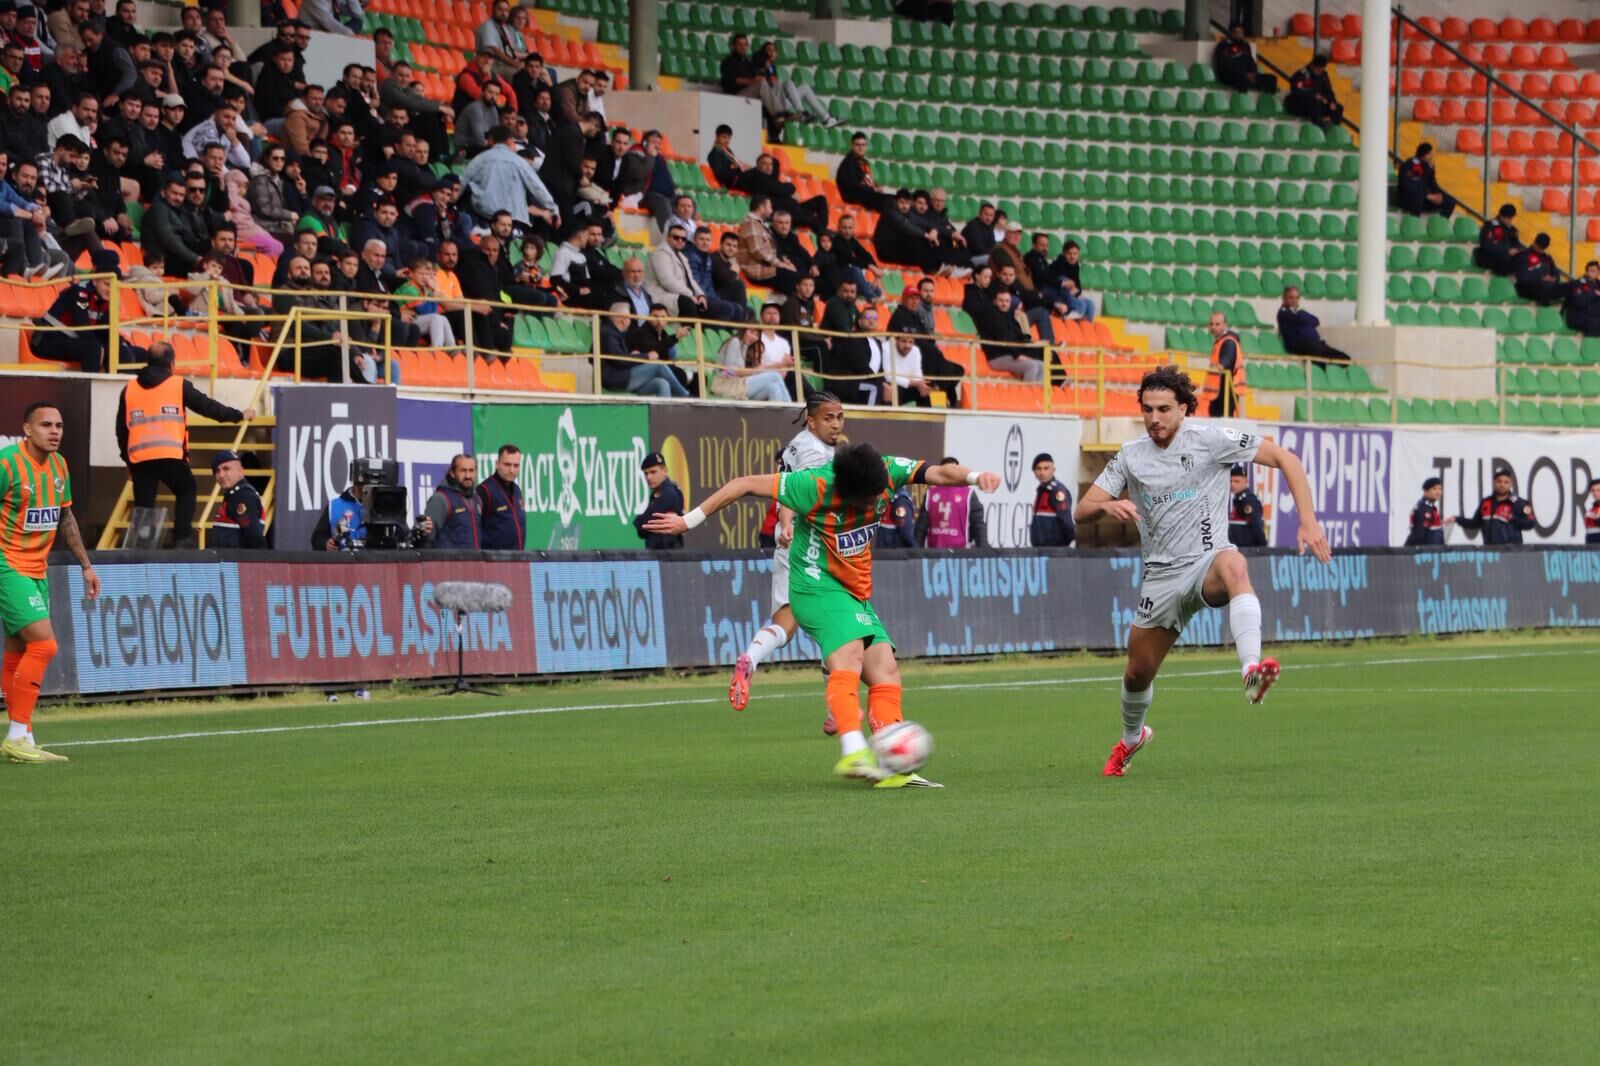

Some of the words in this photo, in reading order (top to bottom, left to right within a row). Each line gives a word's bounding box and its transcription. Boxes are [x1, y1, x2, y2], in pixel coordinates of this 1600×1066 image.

[579, 436, 650, 525] YAKUB
[81, 571, 231, 683] trendyol
[266, 584, 394, 658] FUTBOL
[544, 569, 657, 664] trendyol
